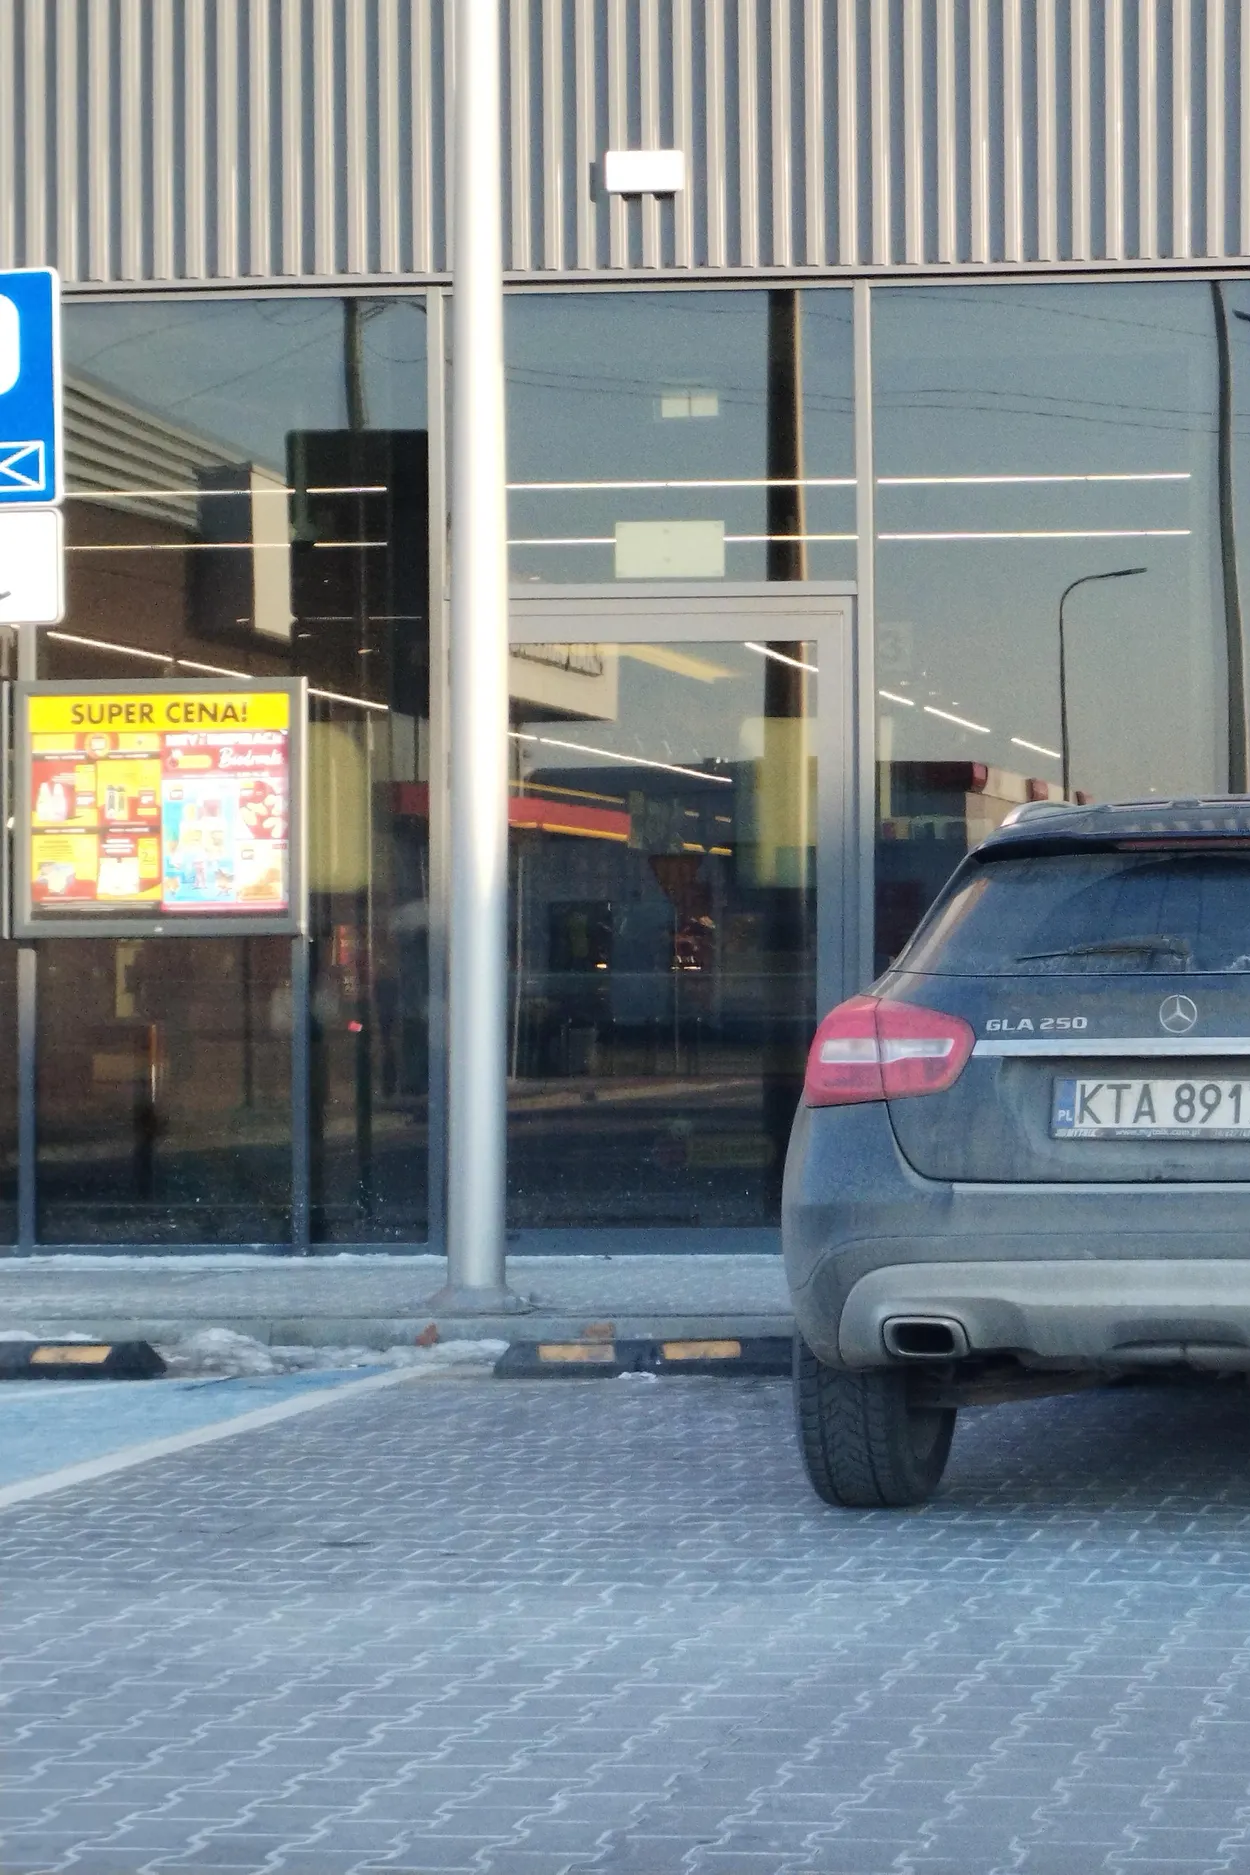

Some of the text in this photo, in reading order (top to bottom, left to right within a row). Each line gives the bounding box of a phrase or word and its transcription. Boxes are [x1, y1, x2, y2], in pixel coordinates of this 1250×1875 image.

[70, 701, 249, 725] SUPER CENA!
[985, 1016, 1088, 1032] GLA 250
[1076, 1083, 1156, 1125] KTA
[1057, 1110, 1074, 1123] PL
